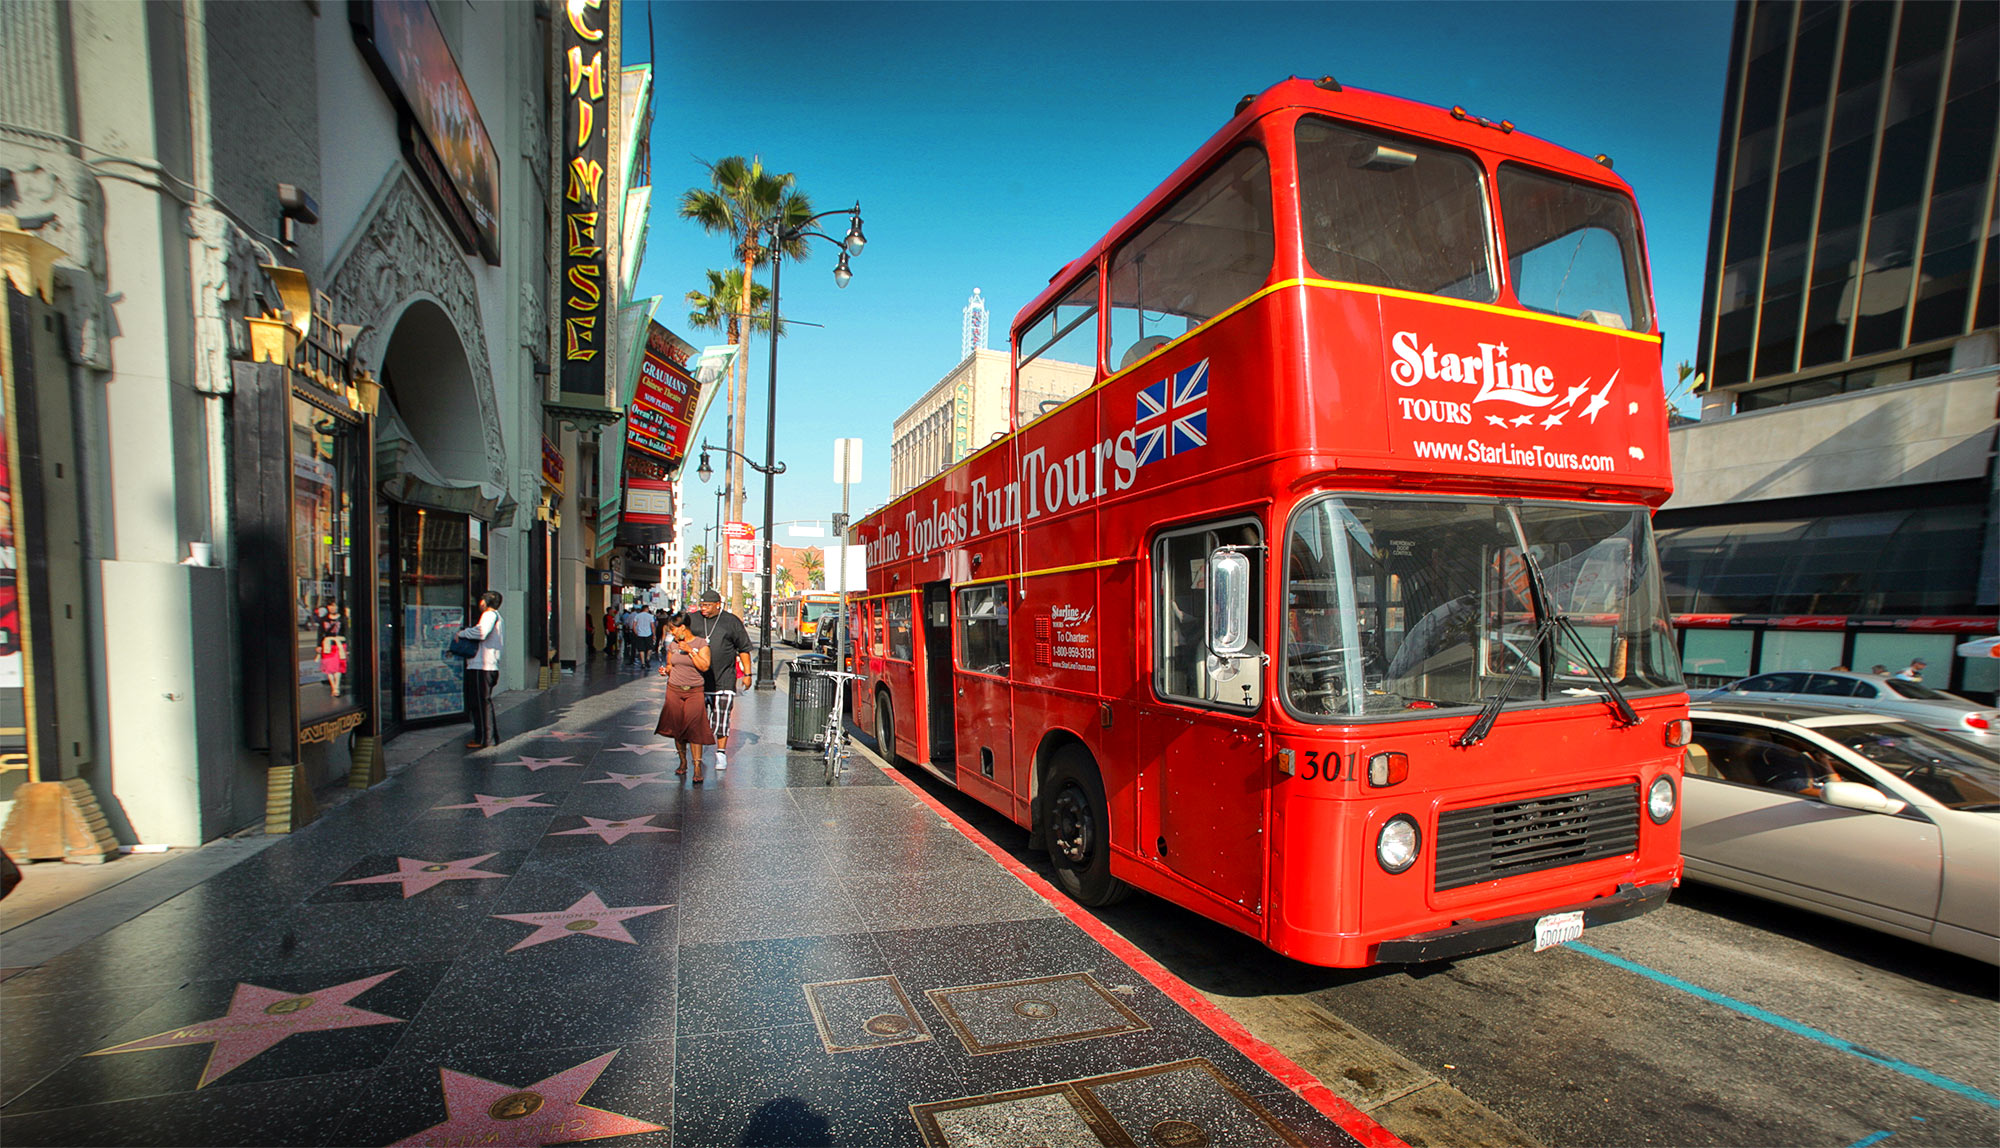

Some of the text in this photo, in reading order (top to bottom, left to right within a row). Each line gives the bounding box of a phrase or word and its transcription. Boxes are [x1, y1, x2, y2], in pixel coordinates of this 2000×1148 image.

[566, 0, 605, 361] CHINESE
[643, 361, 688, 395] GRAUMAN'S
[631, 404, 654, 421] Ocean's
[655, 414, 664, 425] 13
[1398, 397, 1472, 425] TOURS
[1413, 439, 1615, 472] www.StarLineTours.com
[905, 498, 968, 563] Topless
[1056, 631, 1089, 643] To Charter:
[1052, 646, 1095, 659] 1-800-959-3131
[1301, 750, 1358, 782] 301
[532, 909, 638, 921] MARION MARTIN
